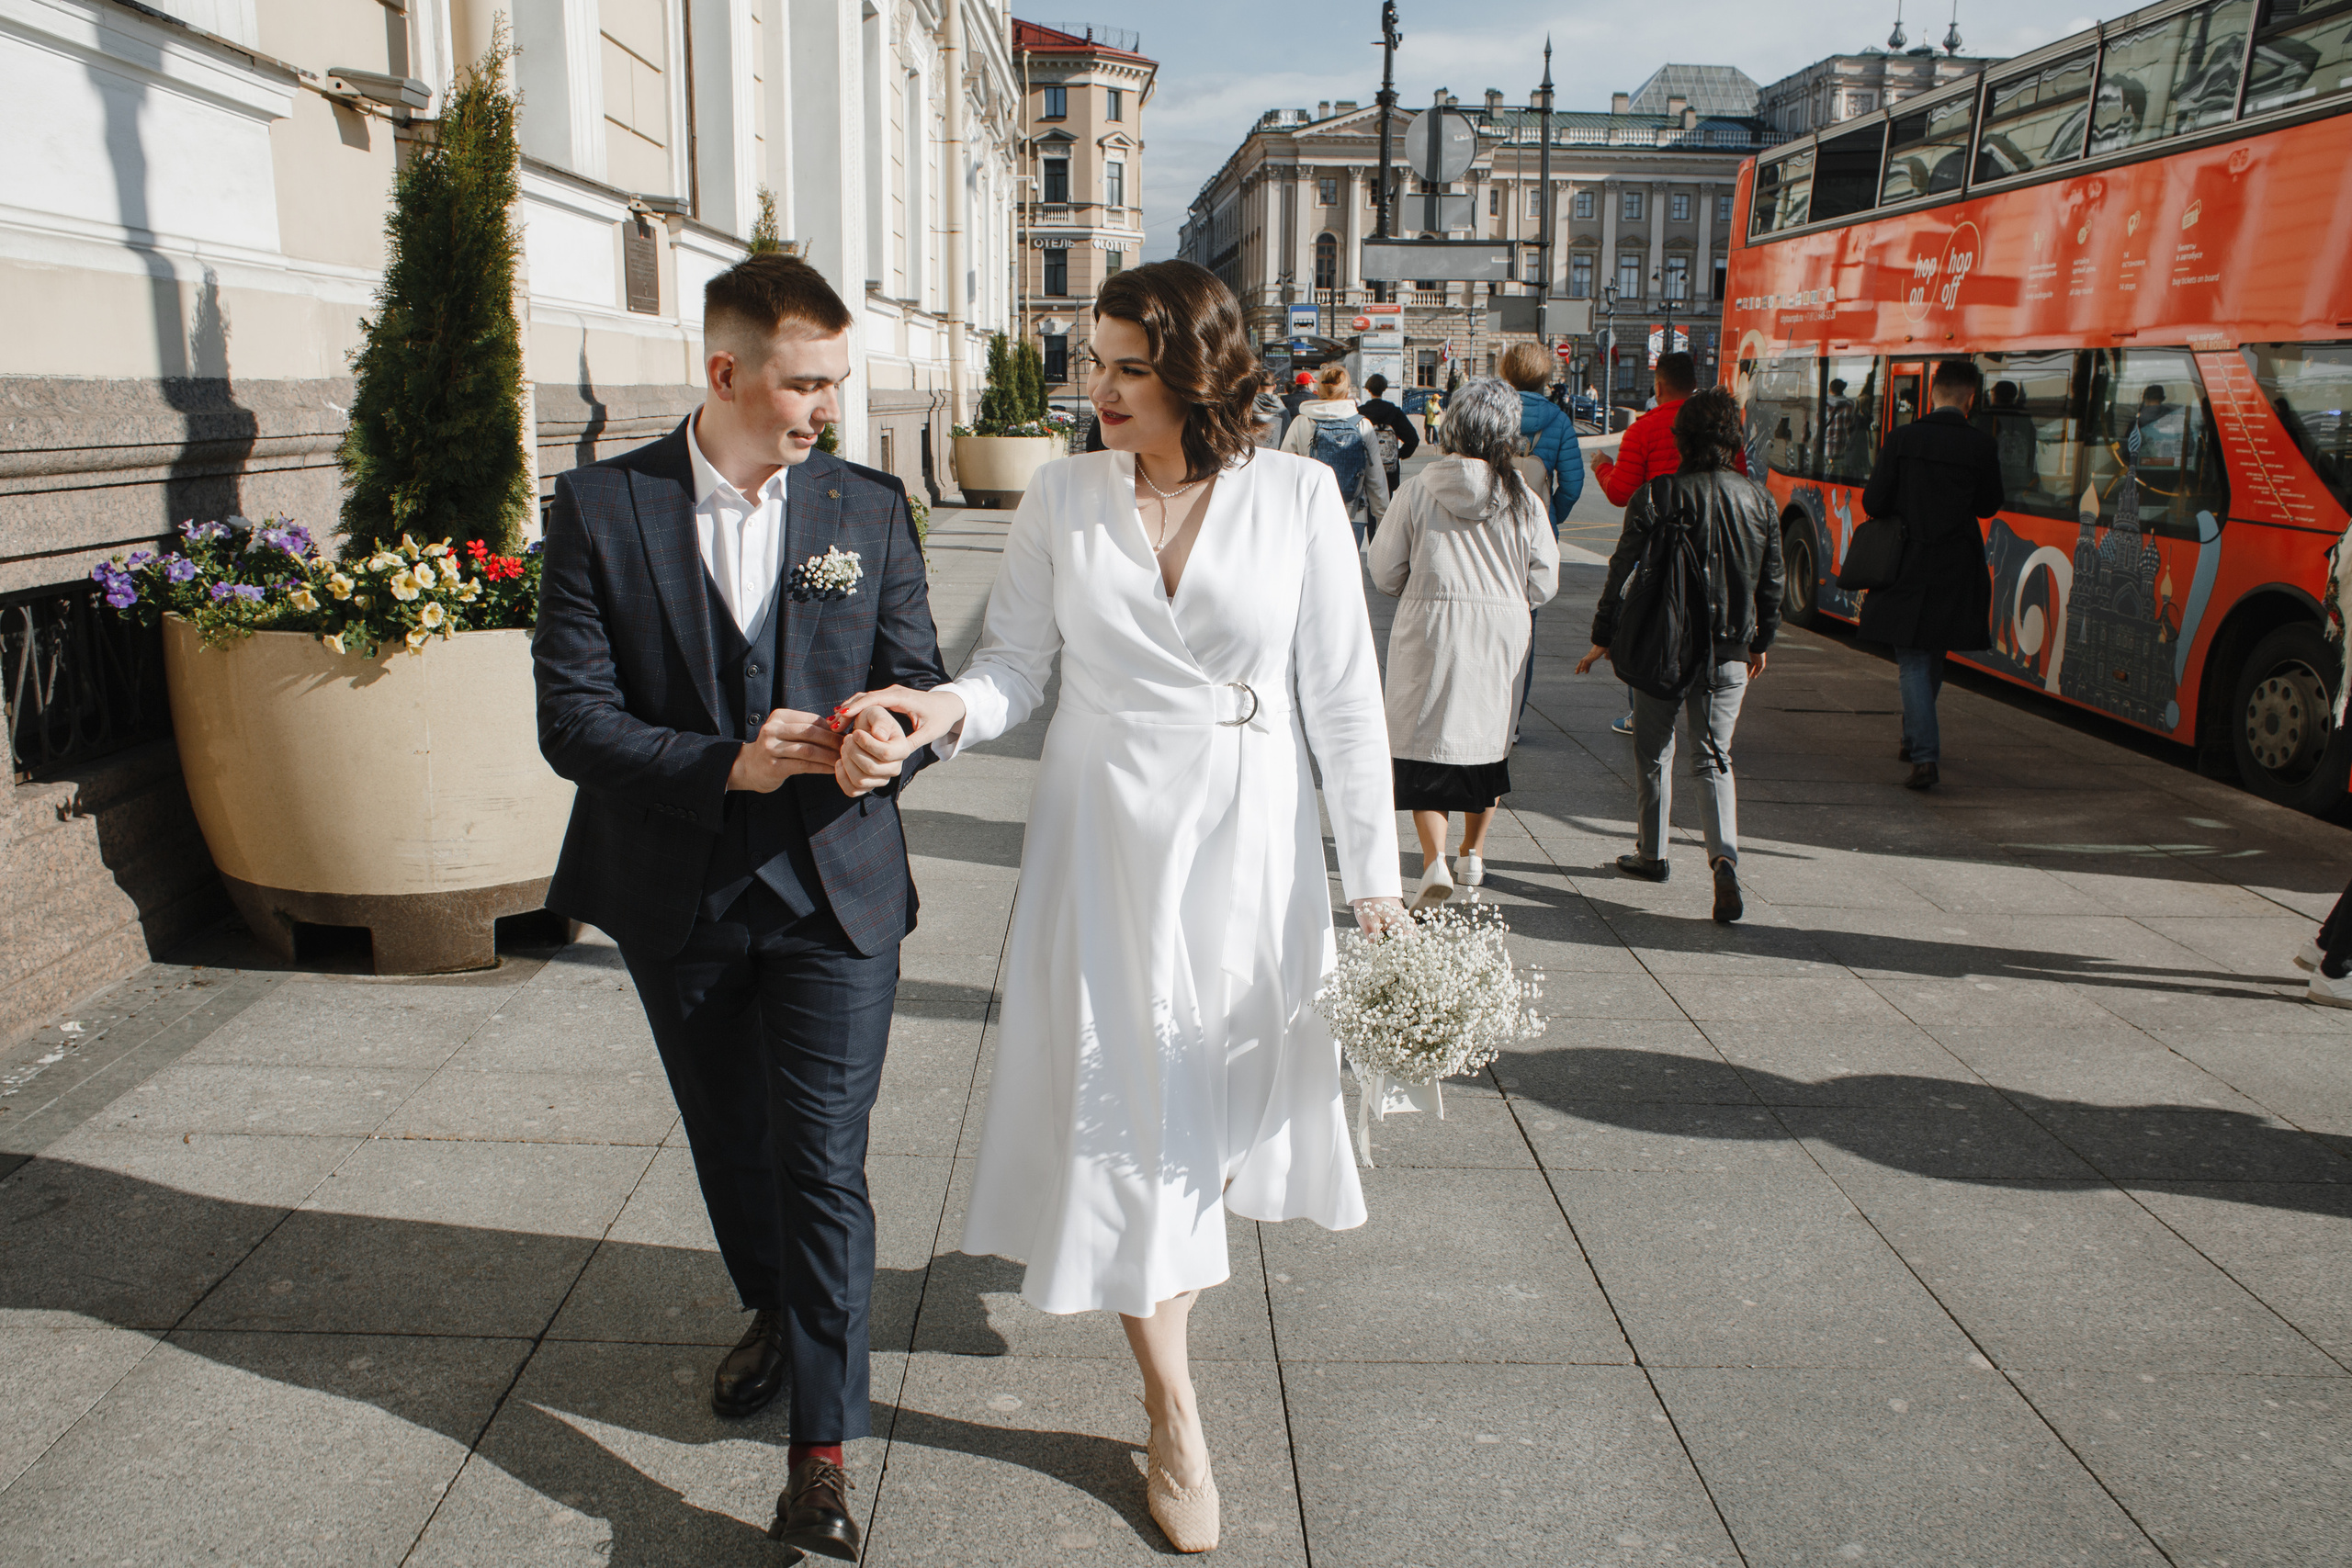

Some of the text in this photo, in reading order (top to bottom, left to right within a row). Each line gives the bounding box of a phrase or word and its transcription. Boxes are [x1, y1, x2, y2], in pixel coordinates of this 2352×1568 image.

[1034, 238, 1076, 248] ОТЕЛЬ
[1099, 239, 1132, 252] LOTTE
[2177, 243, 2197, 252] билеты
[1947, 246, 1973, 280] hop
[2179, 251, 2203, 262] автобусе
[1914, 253, 1938, 285] hop
[2124, 283, 2136, 291] stops
[2172, 277, 2181, 288] buy
[2181, 276, 2197, 285] tickets
[2204, 273, 2220, 283] board
[1909, 287, 1925, 307] on
[1941, 275, 1962, 310] off
[2193, 339, 2231, 351] OUR ROUTE
